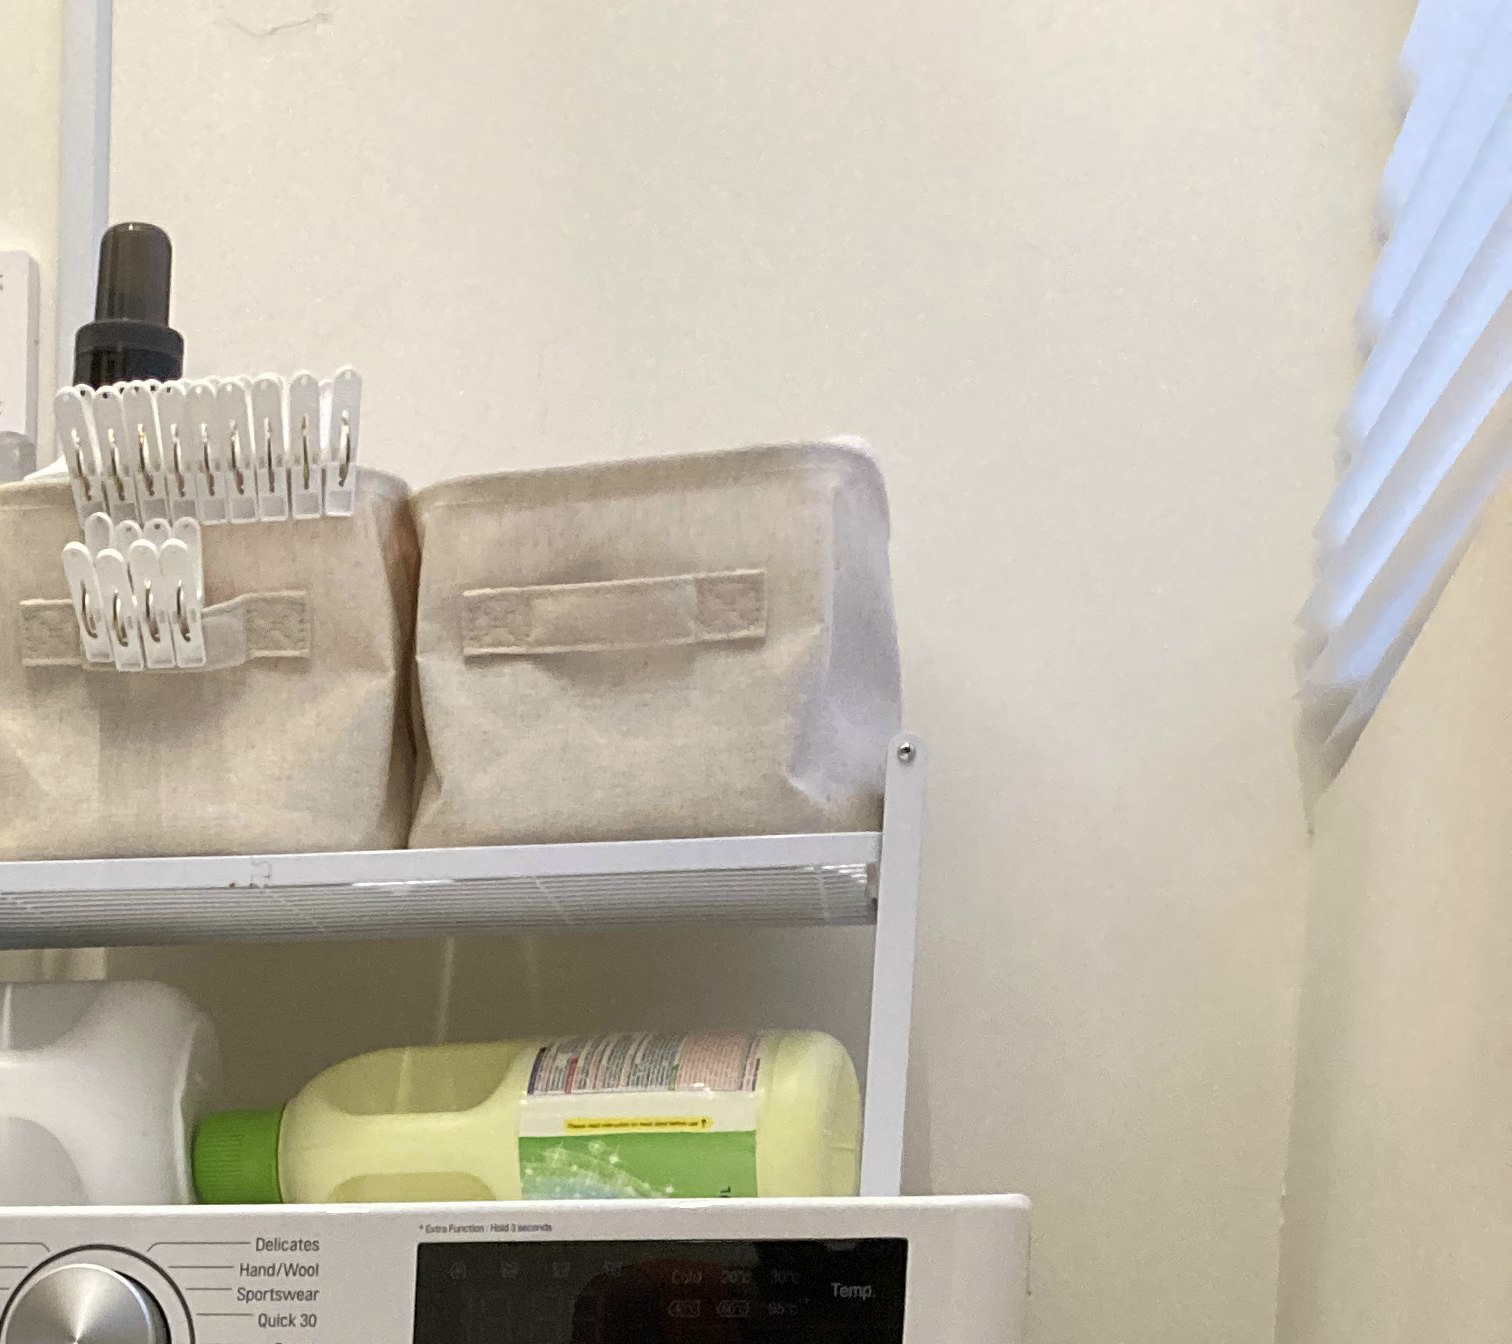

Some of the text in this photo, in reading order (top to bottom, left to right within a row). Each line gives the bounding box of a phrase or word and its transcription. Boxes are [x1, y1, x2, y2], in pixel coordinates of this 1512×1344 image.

[449, 1224, 484, 1233] Function
[490, 1224, 509, 1232] Hold
[518, 1224, 552, 1232] seconds
[255, 1237, 320, 1252] Delicates
[240, 1262, 319, 1277] Hand/Wool
[237, 1286, 320, 1303] Sportswear
[258, 1313, 317, 1328] Quick 30
